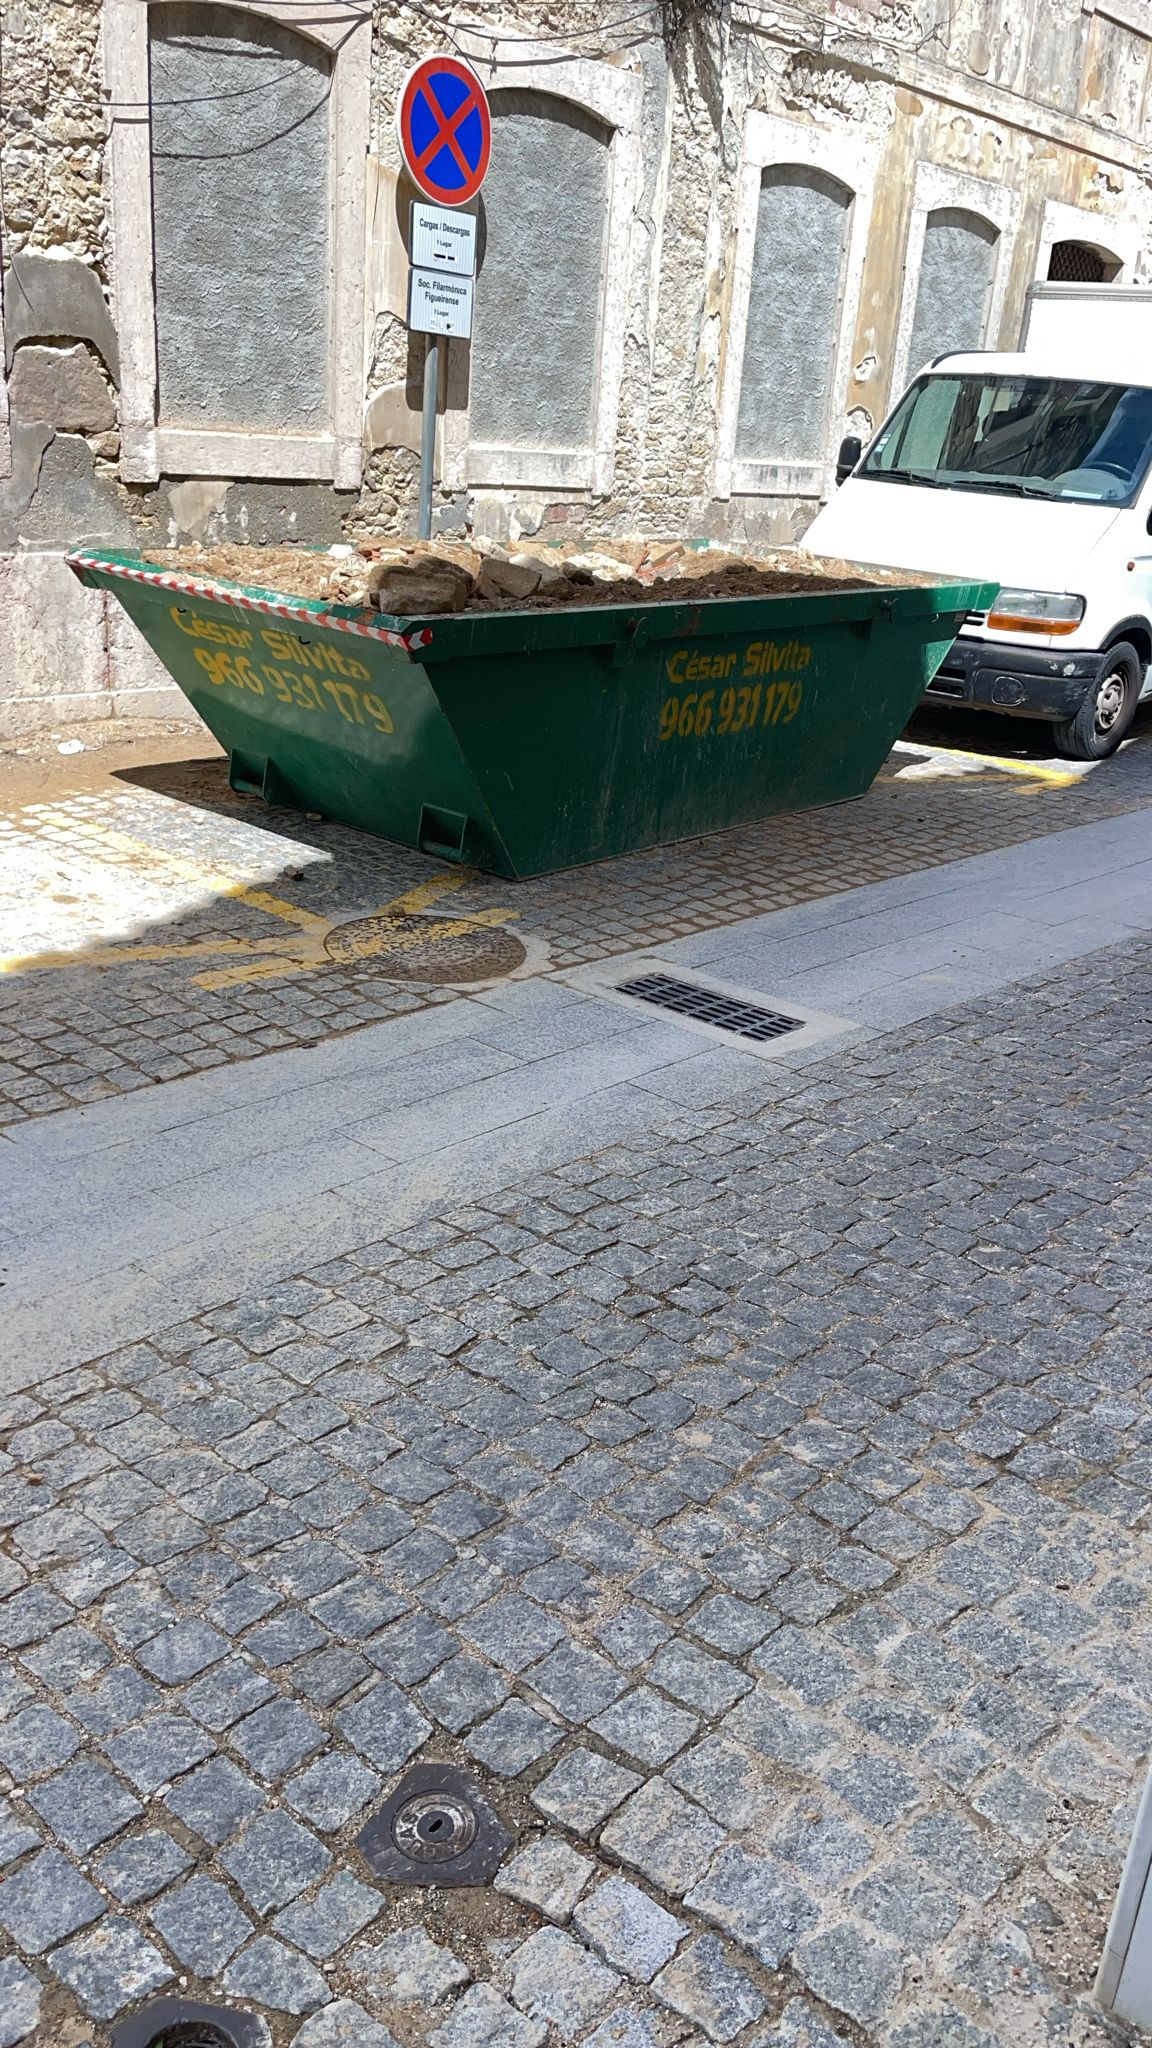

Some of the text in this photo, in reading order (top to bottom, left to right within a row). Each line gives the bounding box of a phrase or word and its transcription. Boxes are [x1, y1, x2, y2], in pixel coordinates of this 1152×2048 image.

[419, 218, 439, 231] Cargas
[442, 223, 470, 238] Descargas
[440, 240, 453, 248] Lugar
[418, 278, 467, 296] Soc. Filarmónica
[424, 292, 459, 306] Figueirense
[170, 607, 254, 649] César
[666, 639, 812, 684] César Silvita
[193, 647, 395, 734] 966 931 179
[659, 679, 803, 741] 966 931 179
